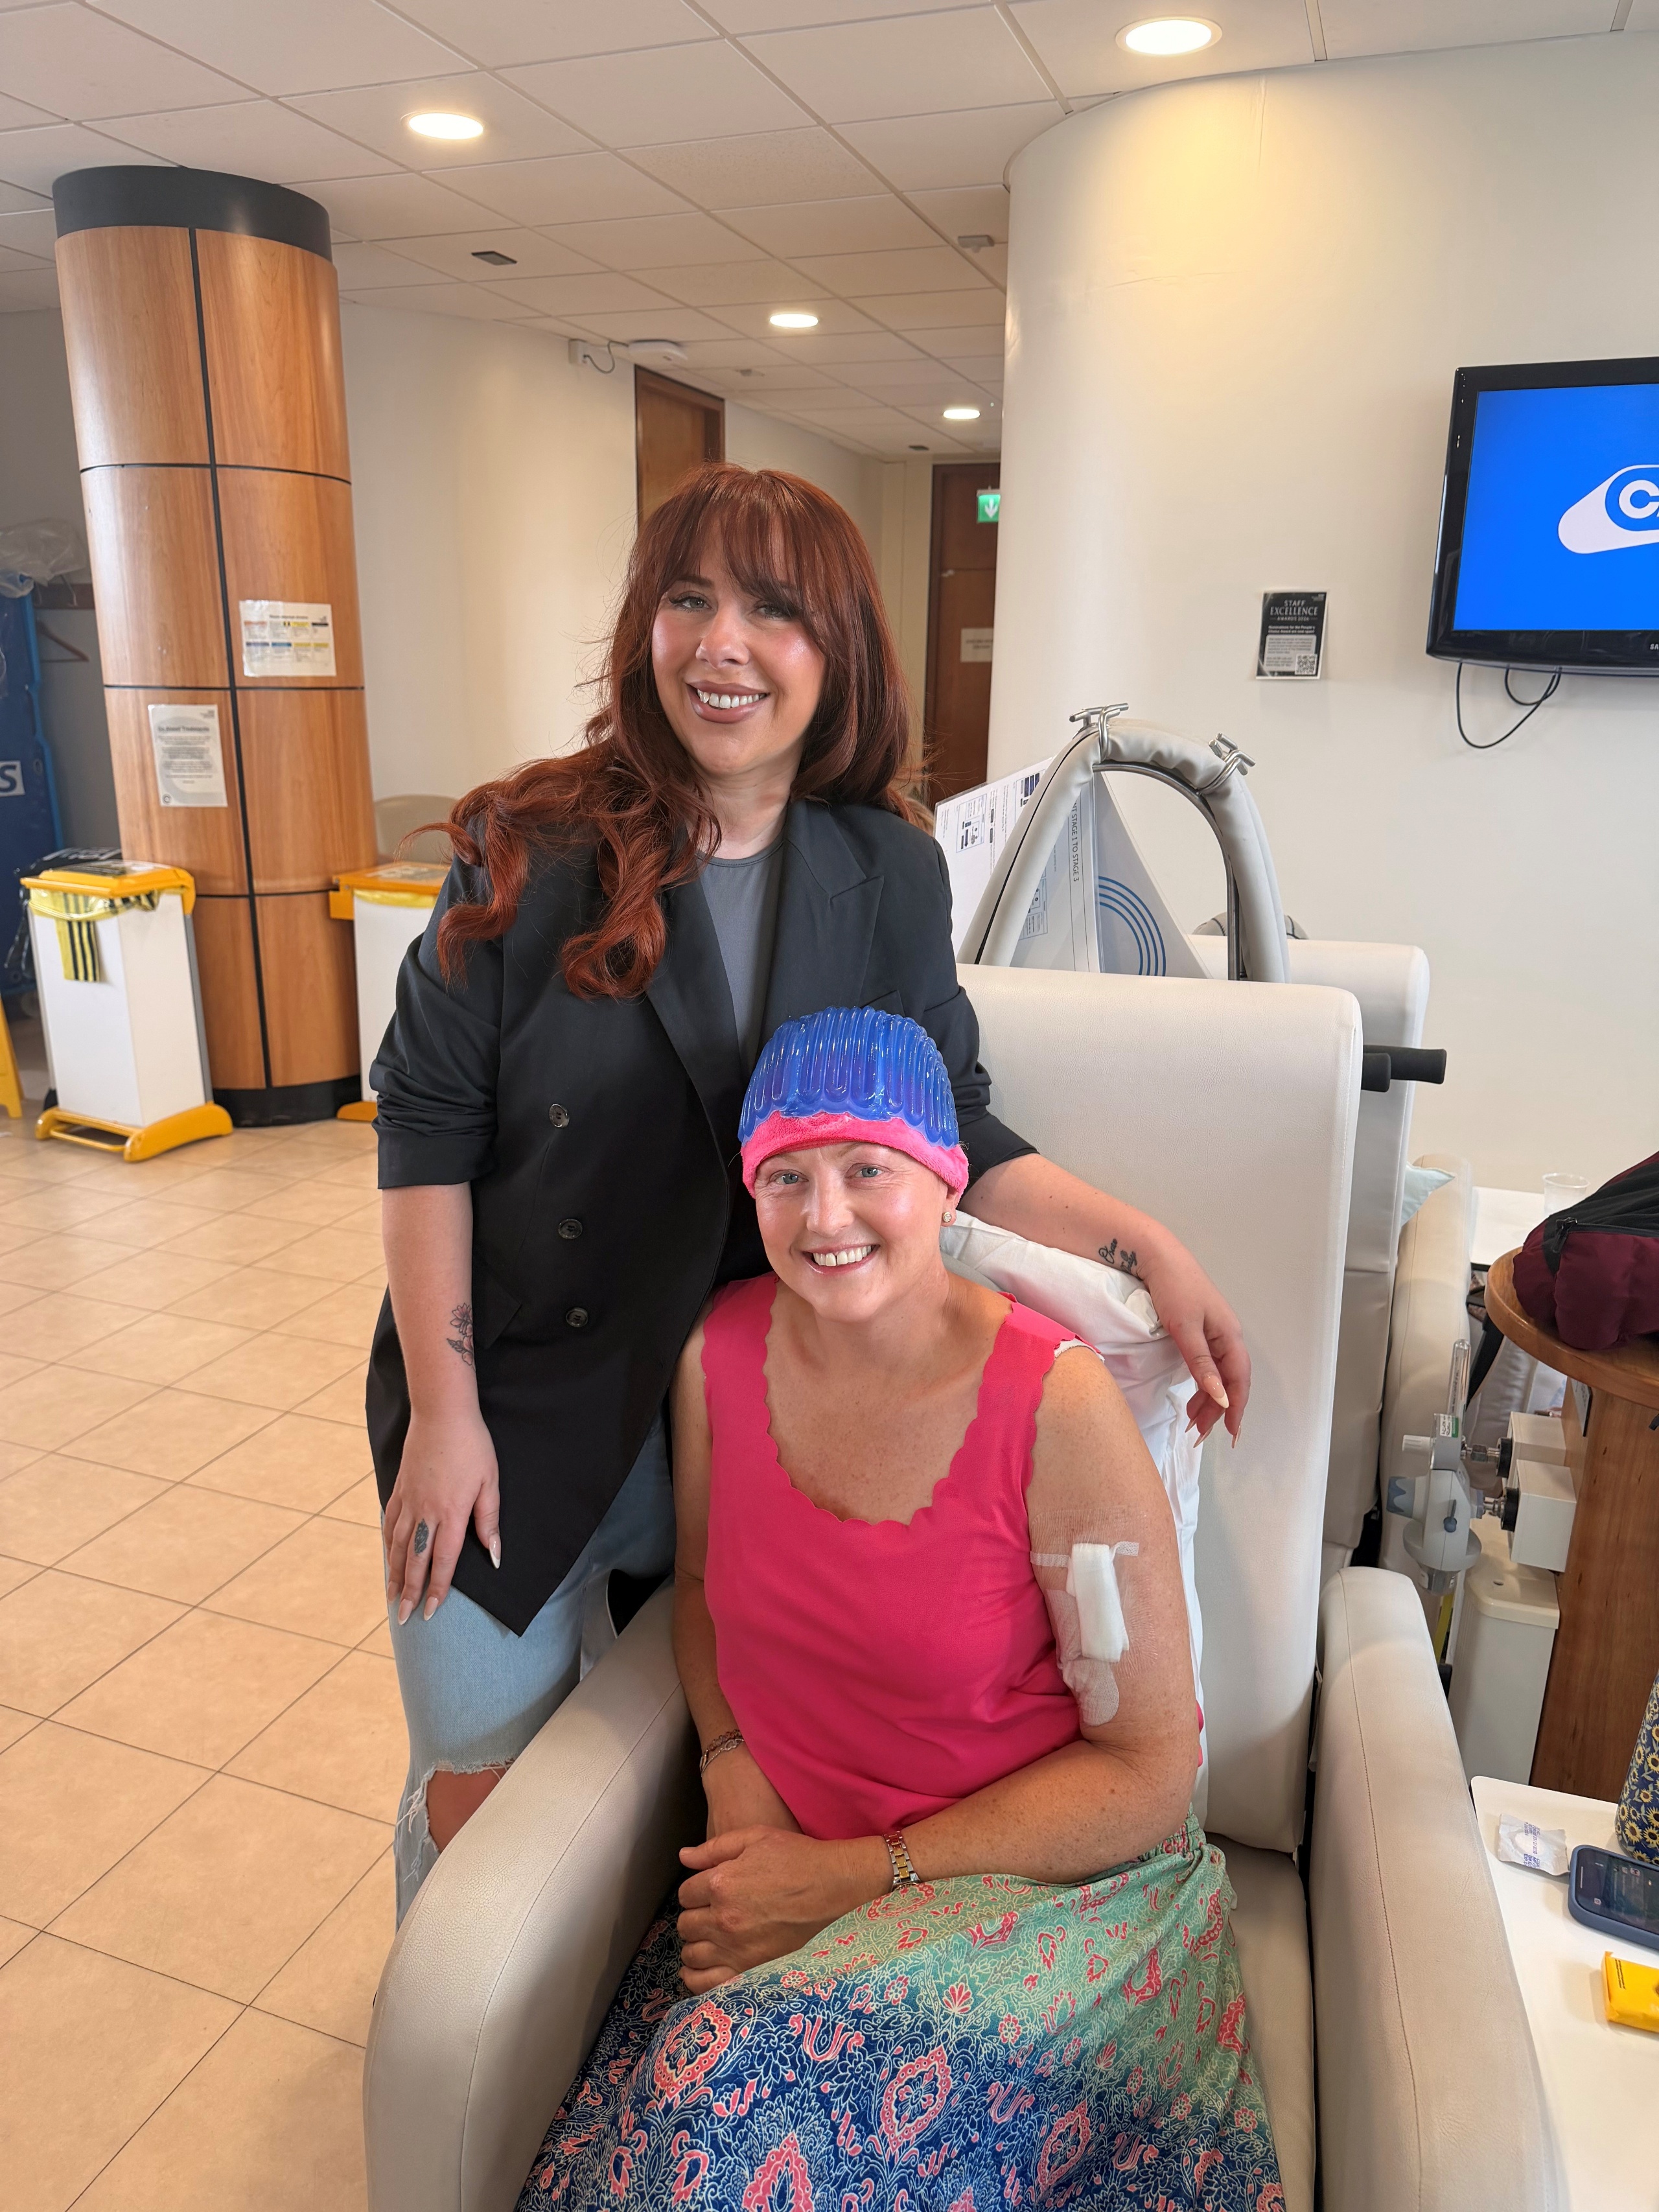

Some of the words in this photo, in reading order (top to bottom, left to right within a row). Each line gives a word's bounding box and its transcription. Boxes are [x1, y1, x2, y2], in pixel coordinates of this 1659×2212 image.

[1619, 480, 1659, 519] C
[1270, 606, 1318, 616] EXCELLENCE
[0, 765, 17, 793] S
[1072, 842, 1078, 852] TO
